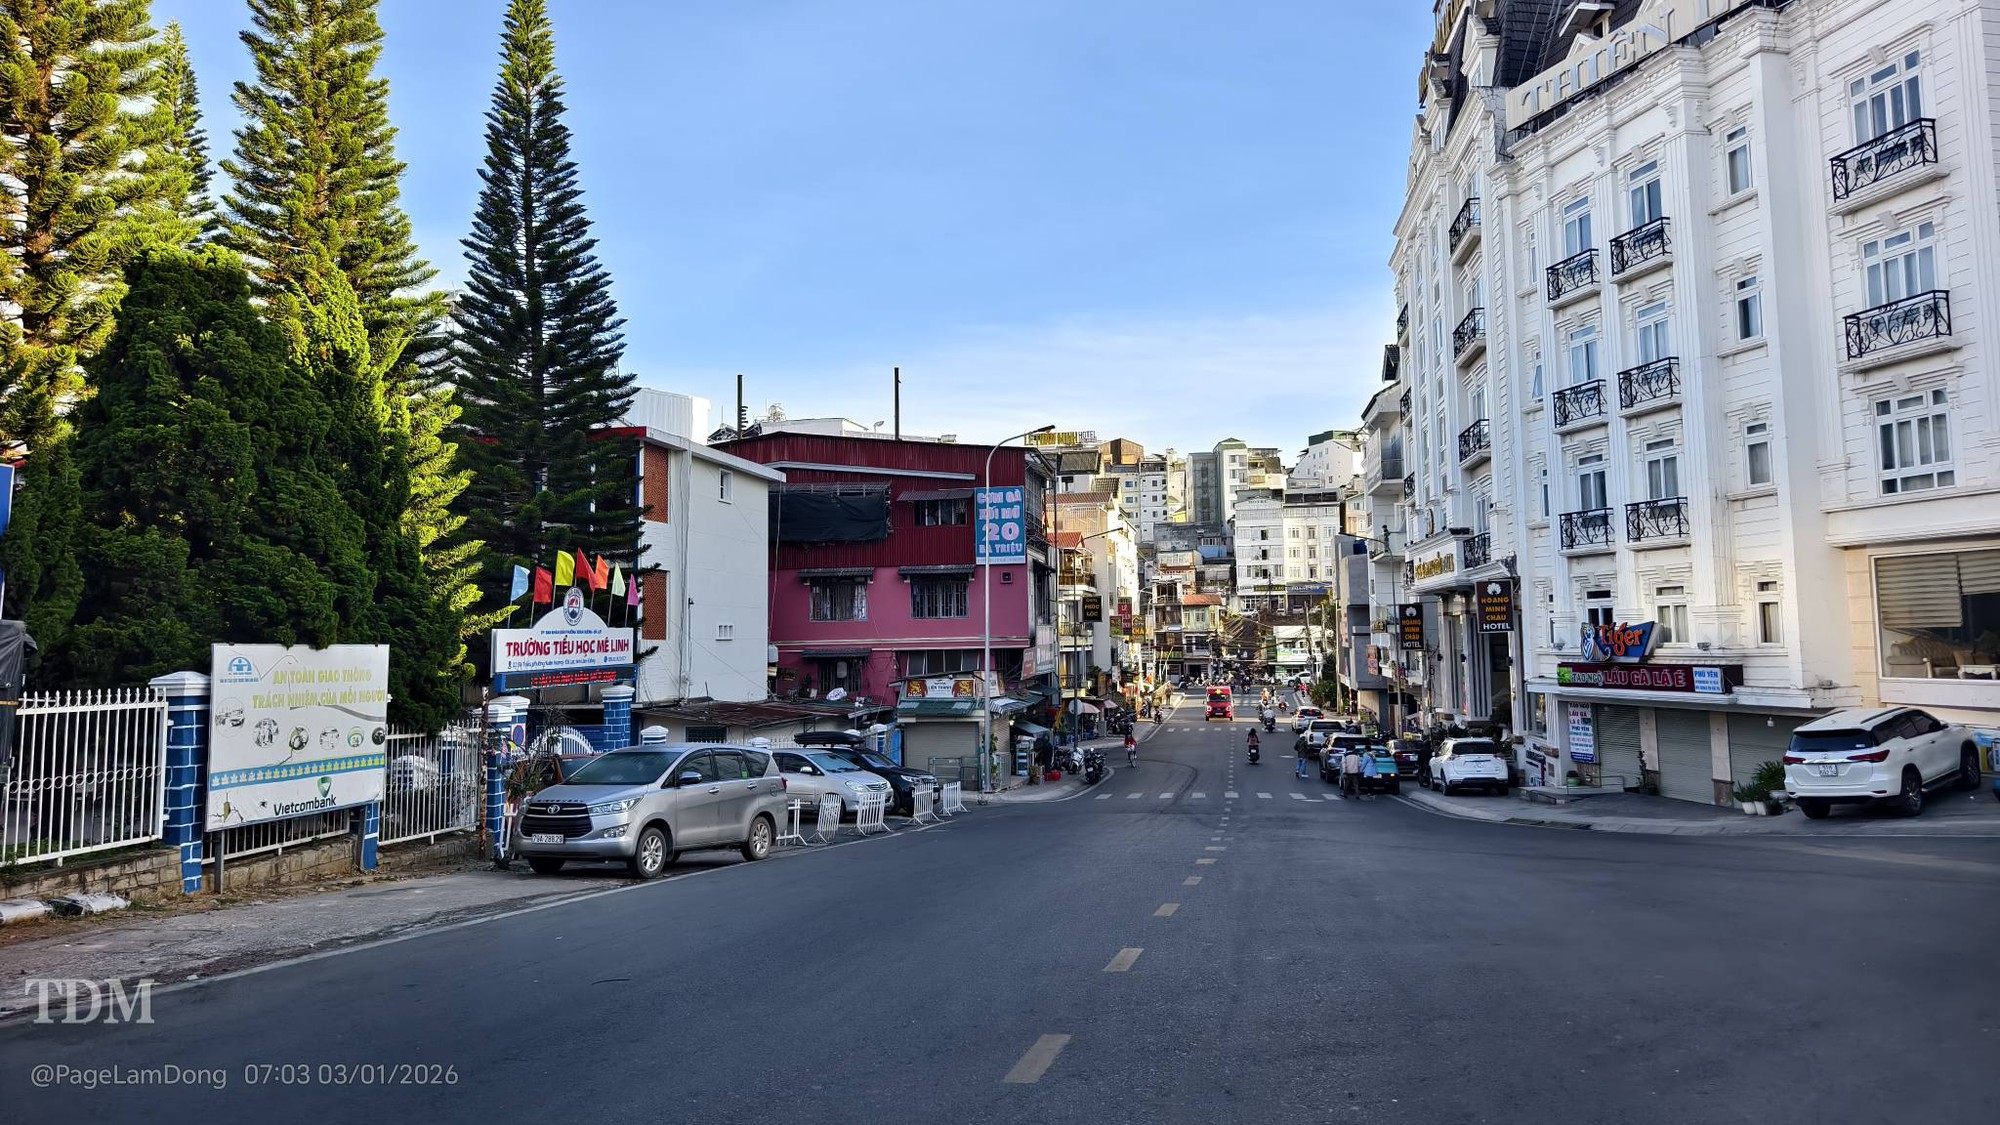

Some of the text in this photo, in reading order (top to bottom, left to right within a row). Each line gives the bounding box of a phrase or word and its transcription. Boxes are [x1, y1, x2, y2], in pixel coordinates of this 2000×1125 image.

[1078, 430, 1096, 439] HOTEL
[1006, 489, 1022, 503] GÀ
[982, 522, 1019, 540] 20
[995, 541, 1022, 554] TRIỆU
[506, 637, 551, 657] TRƯỜNG
[553, 635, 574, 655] TIỂU
[576, 640, 596, 657] HỌC
[610, 639, 629, 653] LINH
[1596, 622, 1643, 655] Tiger
[273, 671, 287, 684] AN
[289, 668, 315, 684] TOÀN
[318, 670, 339, 683] GIAO
[343, 669, 372, 683] THÔNG
[1604, 666, 1628, 685] LẨU
[1631, 668, 1650, 686] GÀ
[1652, 667, 1672, 687] LÁ
[1674, 669, 1686, 688] É
[1694, 669, 1718, 678] PHÚ YÊN
[253, 692, 285, 709] TRÁCH
[288, 692, 318, 709] NHIỆM
[321, 689, 337, 706] CỦA
[359, 687, 386, 704] NGƯỜI
[273, 794, 337, 816] Vietcombank
